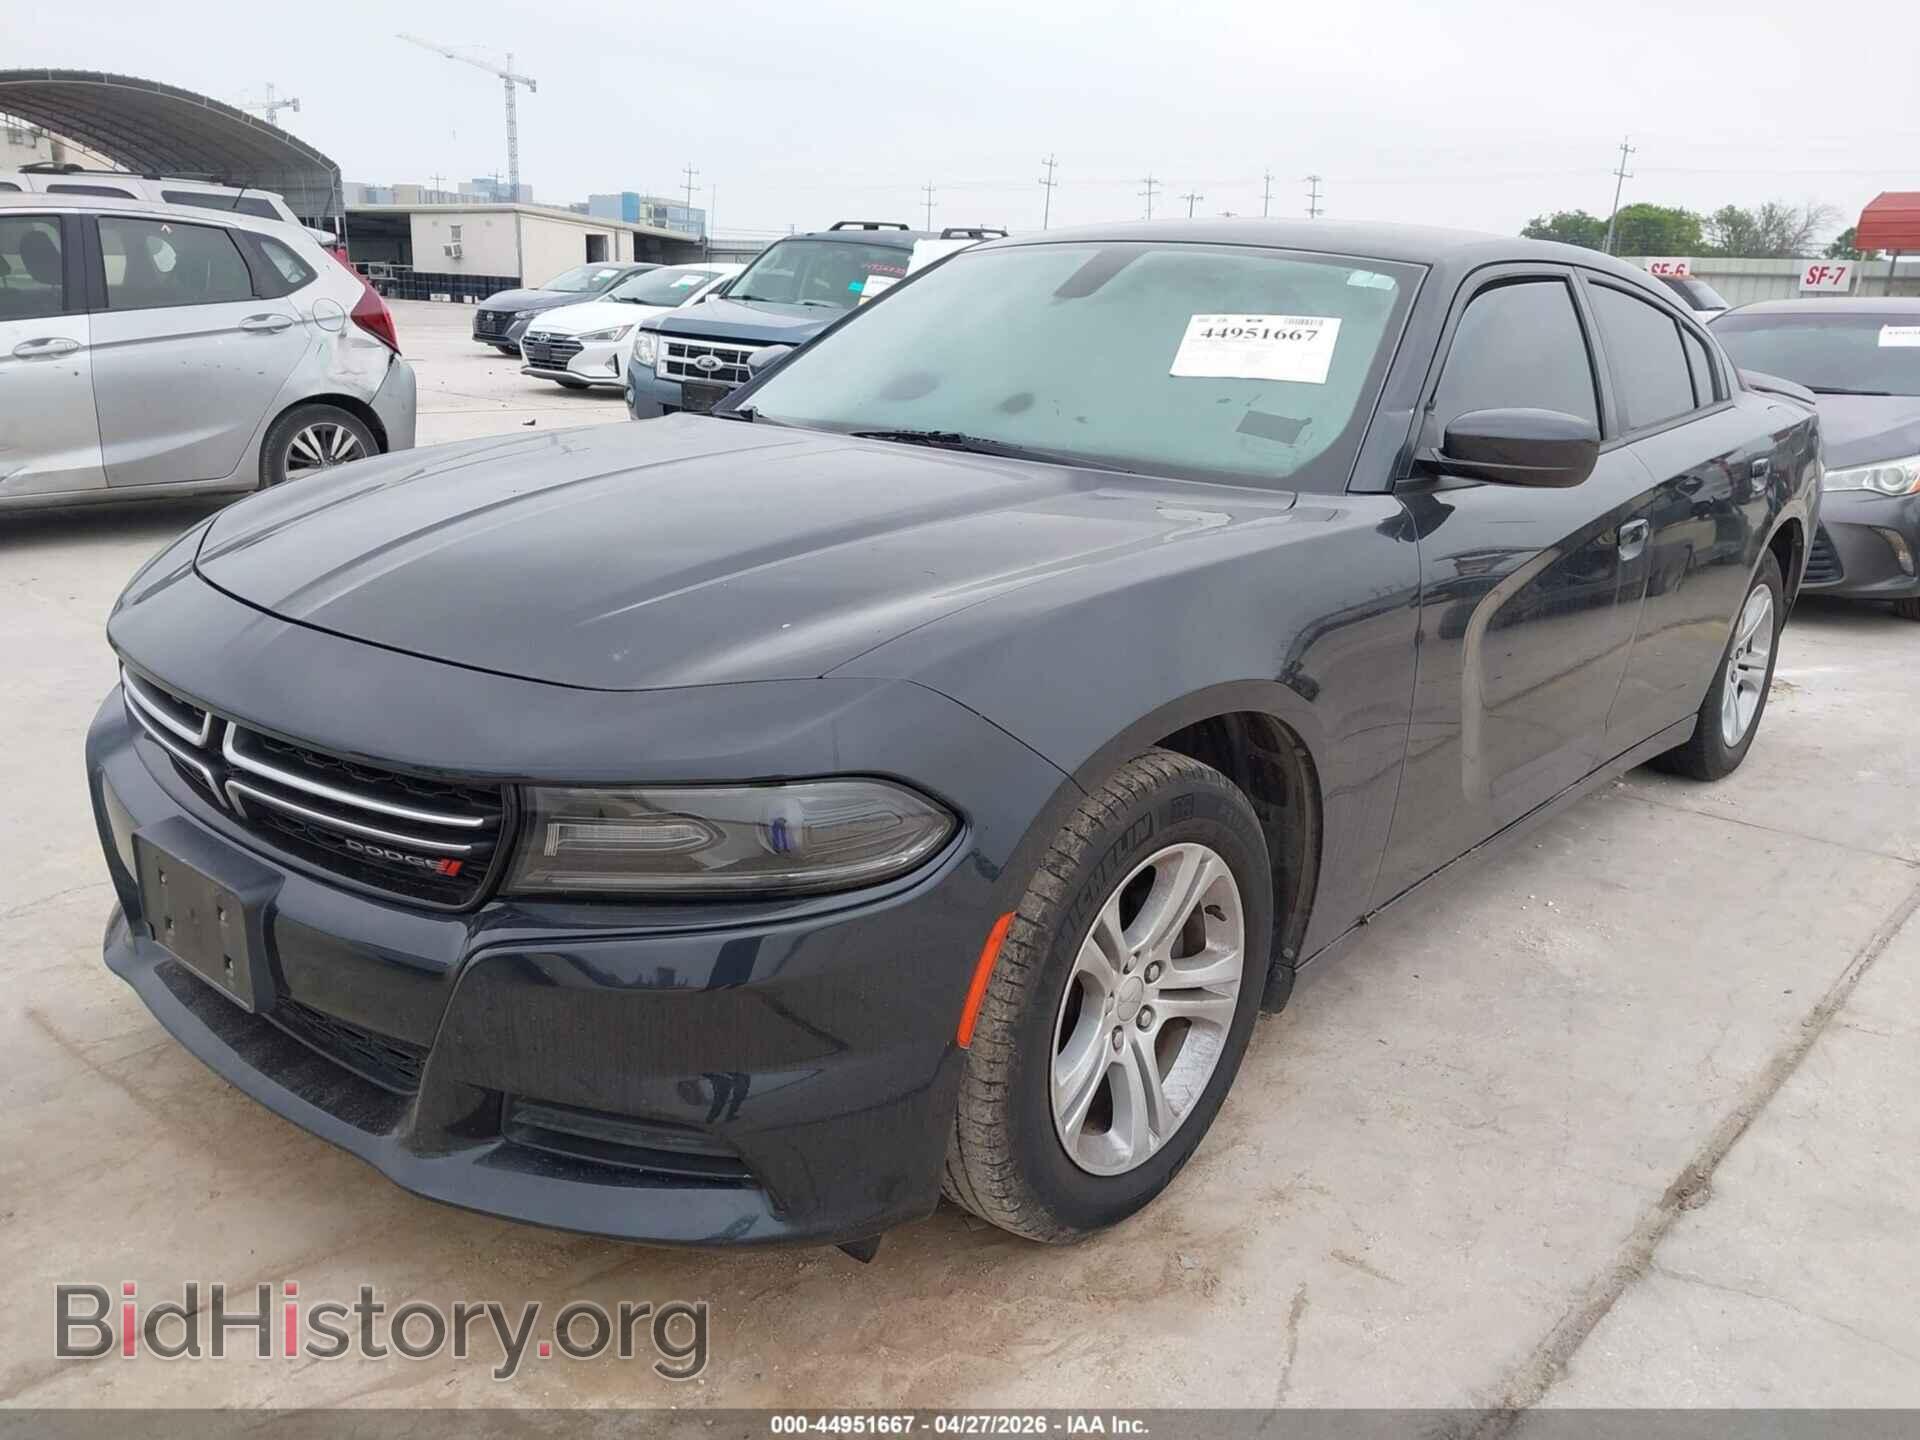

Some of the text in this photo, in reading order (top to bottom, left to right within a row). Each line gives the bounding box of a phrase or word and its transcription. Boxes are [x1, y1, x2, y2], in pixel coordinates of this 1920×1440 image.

[1806, 265, 1846, 285] SF-7
[1200, 327, 1318, 341] 44951667
[345, 839, 443, 870] DODGE
